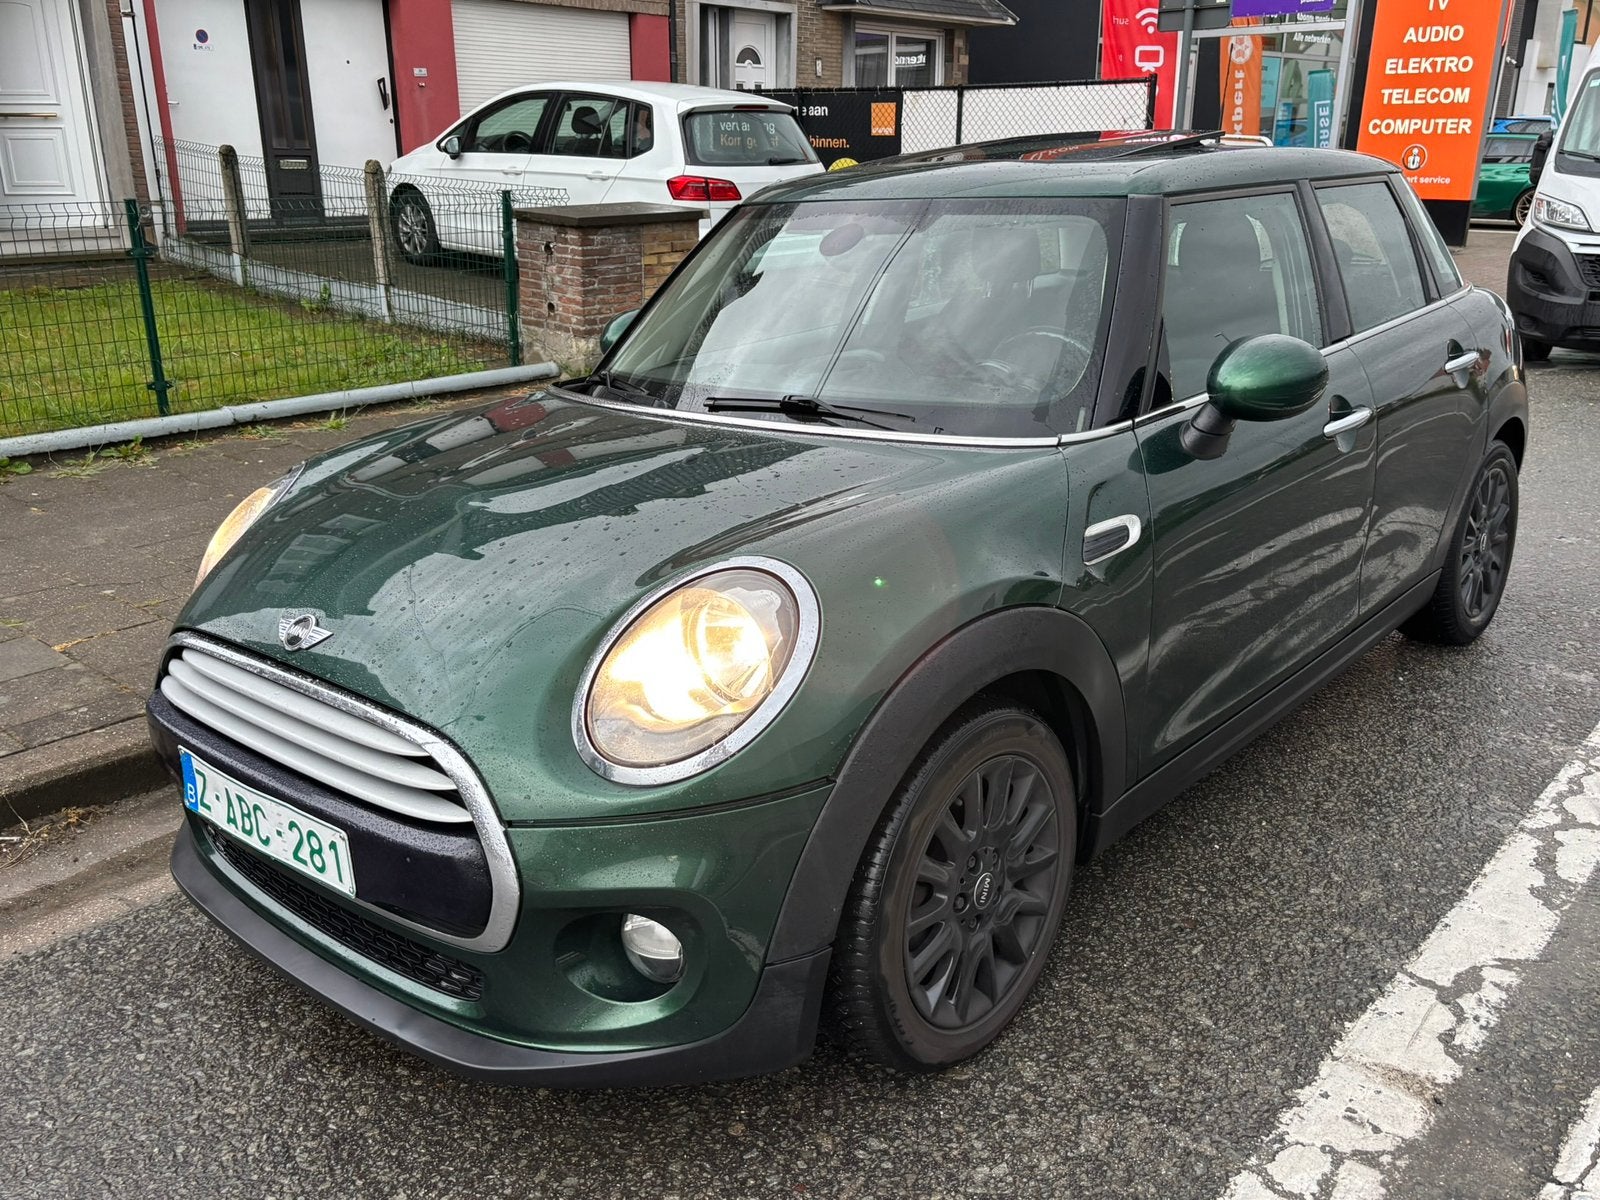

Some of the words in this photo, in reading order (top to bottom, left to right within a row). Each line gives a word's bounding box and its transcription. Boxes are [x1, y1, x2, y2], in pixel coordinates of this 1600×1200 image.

[1428, 0, 1449, 11] TV
[1403, 25, 1465, 43] AUDIO
[1385, 56, 1474, 75] ELEKTRO
[1381, 87, 1471, 105] TELECOM
[808, 105, 828, 116] aan
[1368, 118, 1472, 135] COMPUTER
[809, 135, 850, 148] binnen.
[1419, 176, 1451, 184] service
[187, 784, 196, 803] B
[979, 877, 991, 904] MINI
